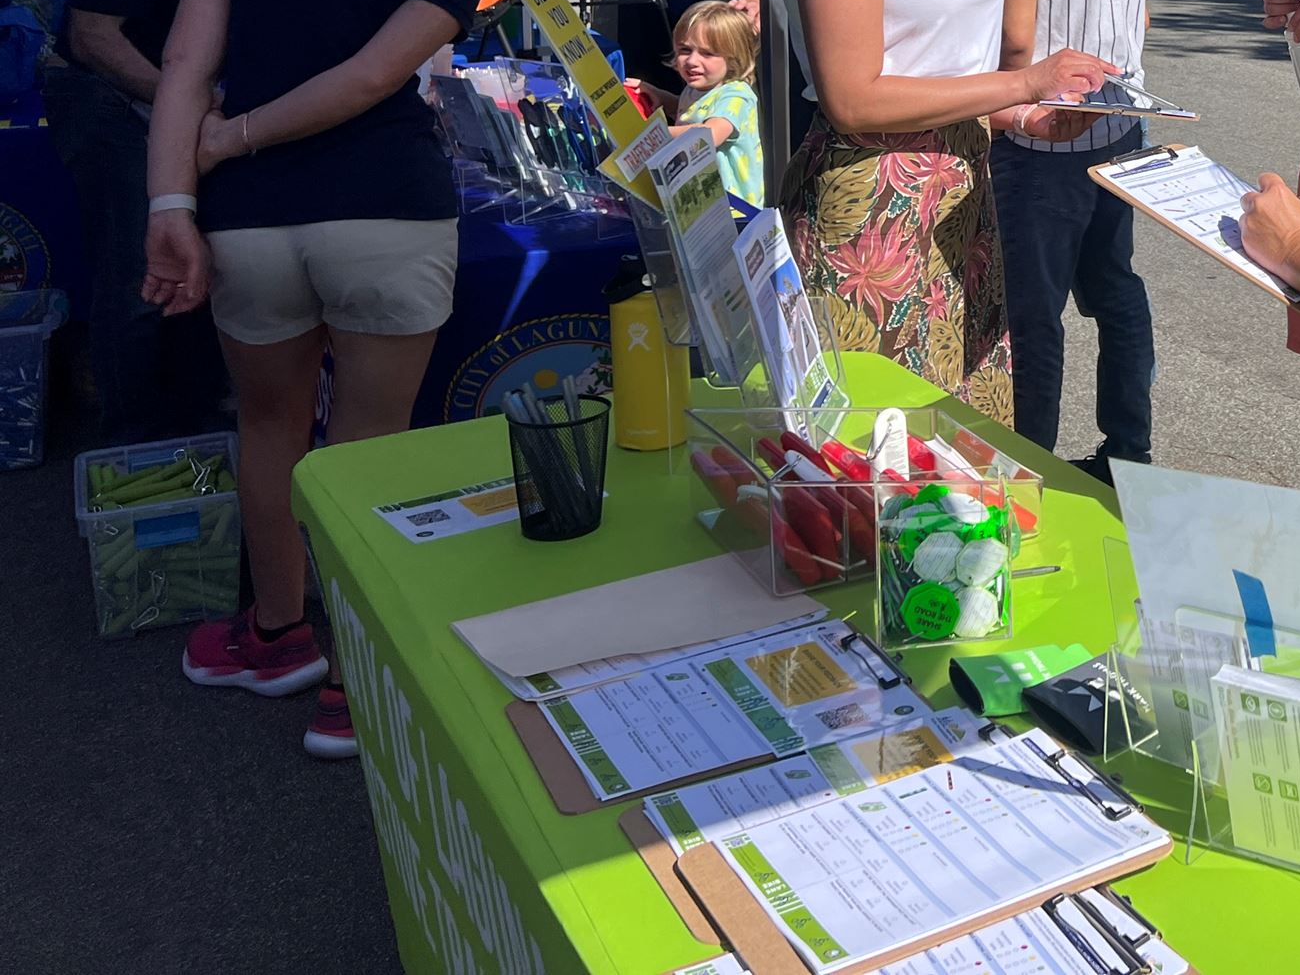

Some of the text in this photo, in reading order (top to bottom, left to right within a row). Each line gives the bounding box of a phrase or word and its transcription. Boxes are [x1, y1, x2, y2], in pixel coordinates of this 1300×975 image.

[547, 5, 569, 29] YOU
[560, 35, 588, 65] KNOW
[623, 140, 647, 174] TRAFFIC
[644, 124, 667, 156] SAFETY
[453, 362, 490, 409] CITY
[508, 321, 609, 353] LAGUN
